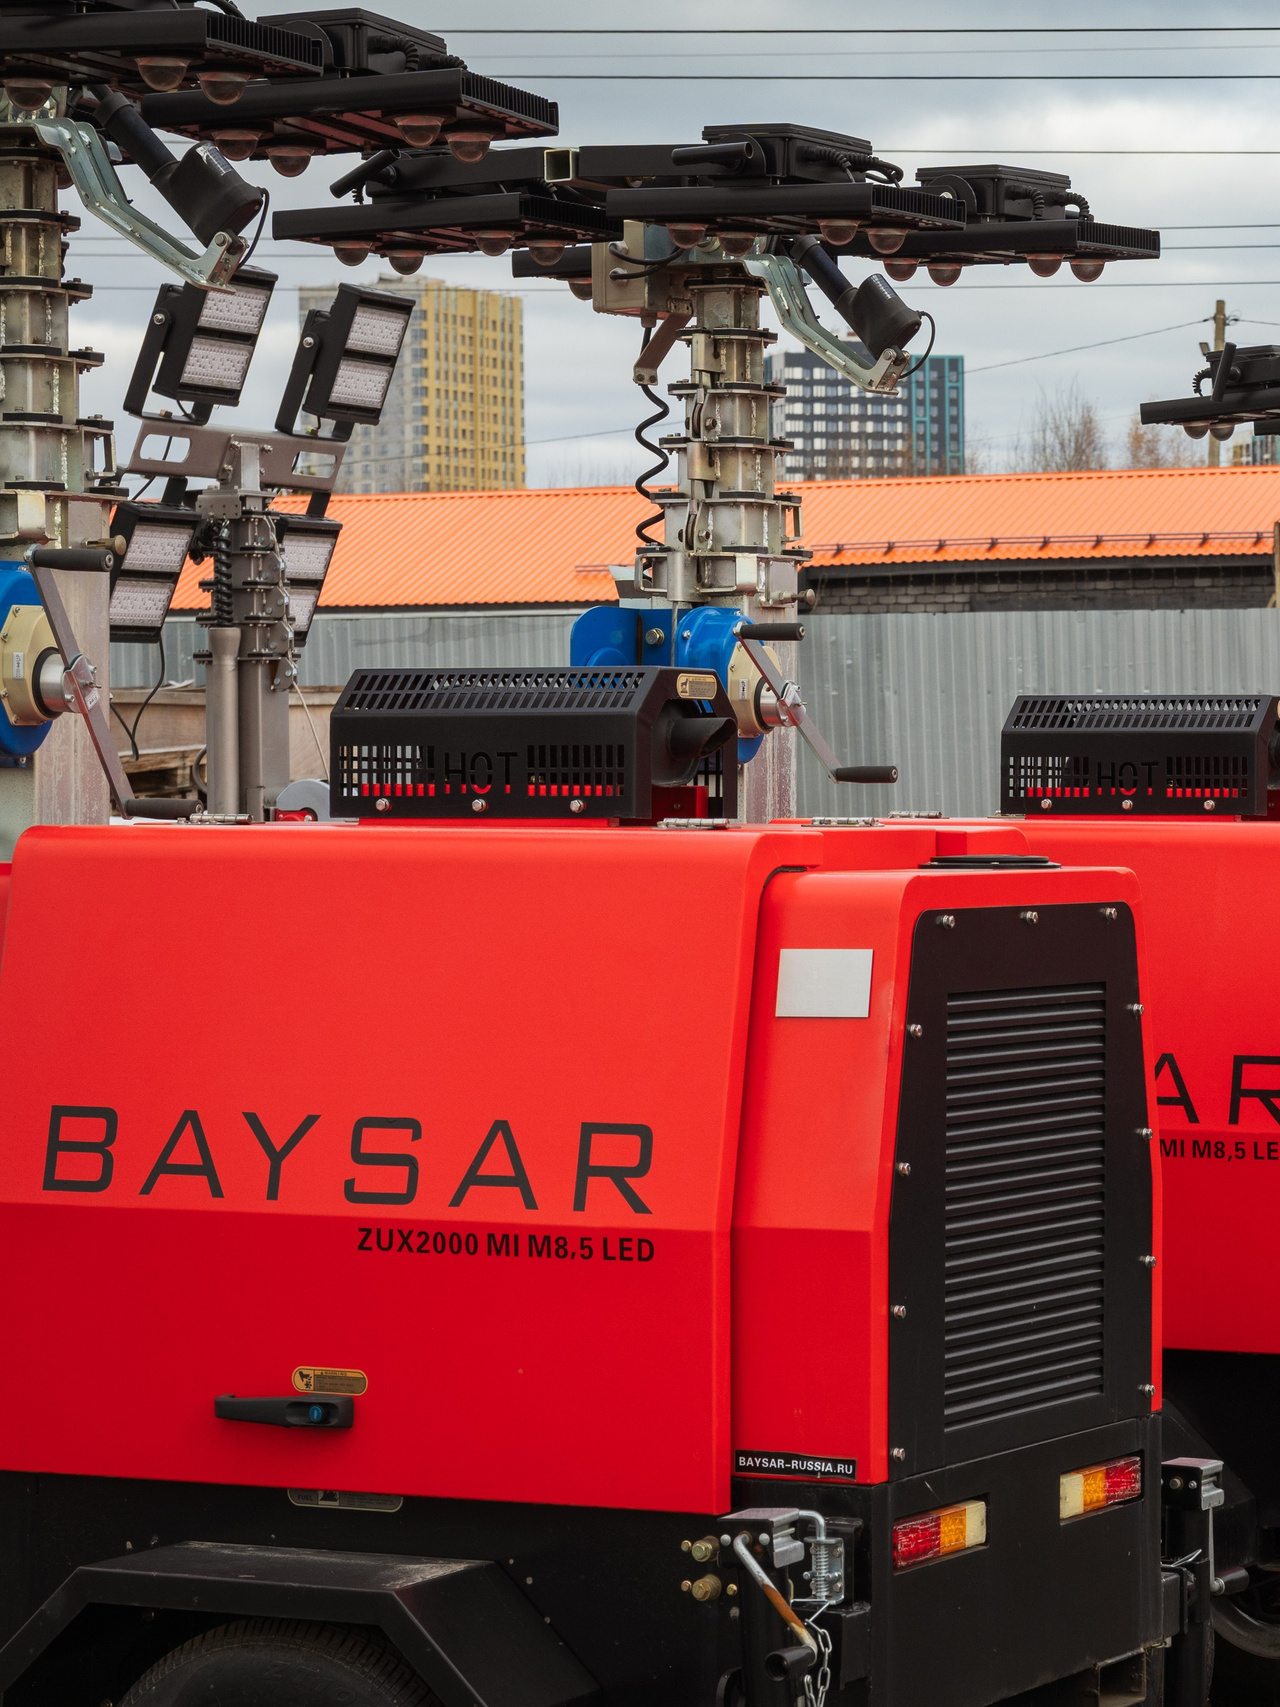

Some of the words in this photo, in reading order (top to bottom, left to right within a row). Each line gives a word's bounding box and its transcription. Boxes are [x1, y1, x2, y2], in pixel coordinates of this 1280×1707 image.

[445, 751, 518, 794] HOT
[1097, 762, 1159, 795] HOT
[42, 1105, 654, 1215] BAYSAR
[1159, 1139, 1184, 1158] MI
[1193, 1140, 1246, 1162] M8,5
[357, 1228, 479, 1255] ZUX2000
[487, 1233, 519, 1257] MI
[528, 1234, 593, 1260] M8,5
[602, 1237, 655, 1262] LED
[738, 1456, 853, 1474] BAYSAR-RUSSIA.RU
